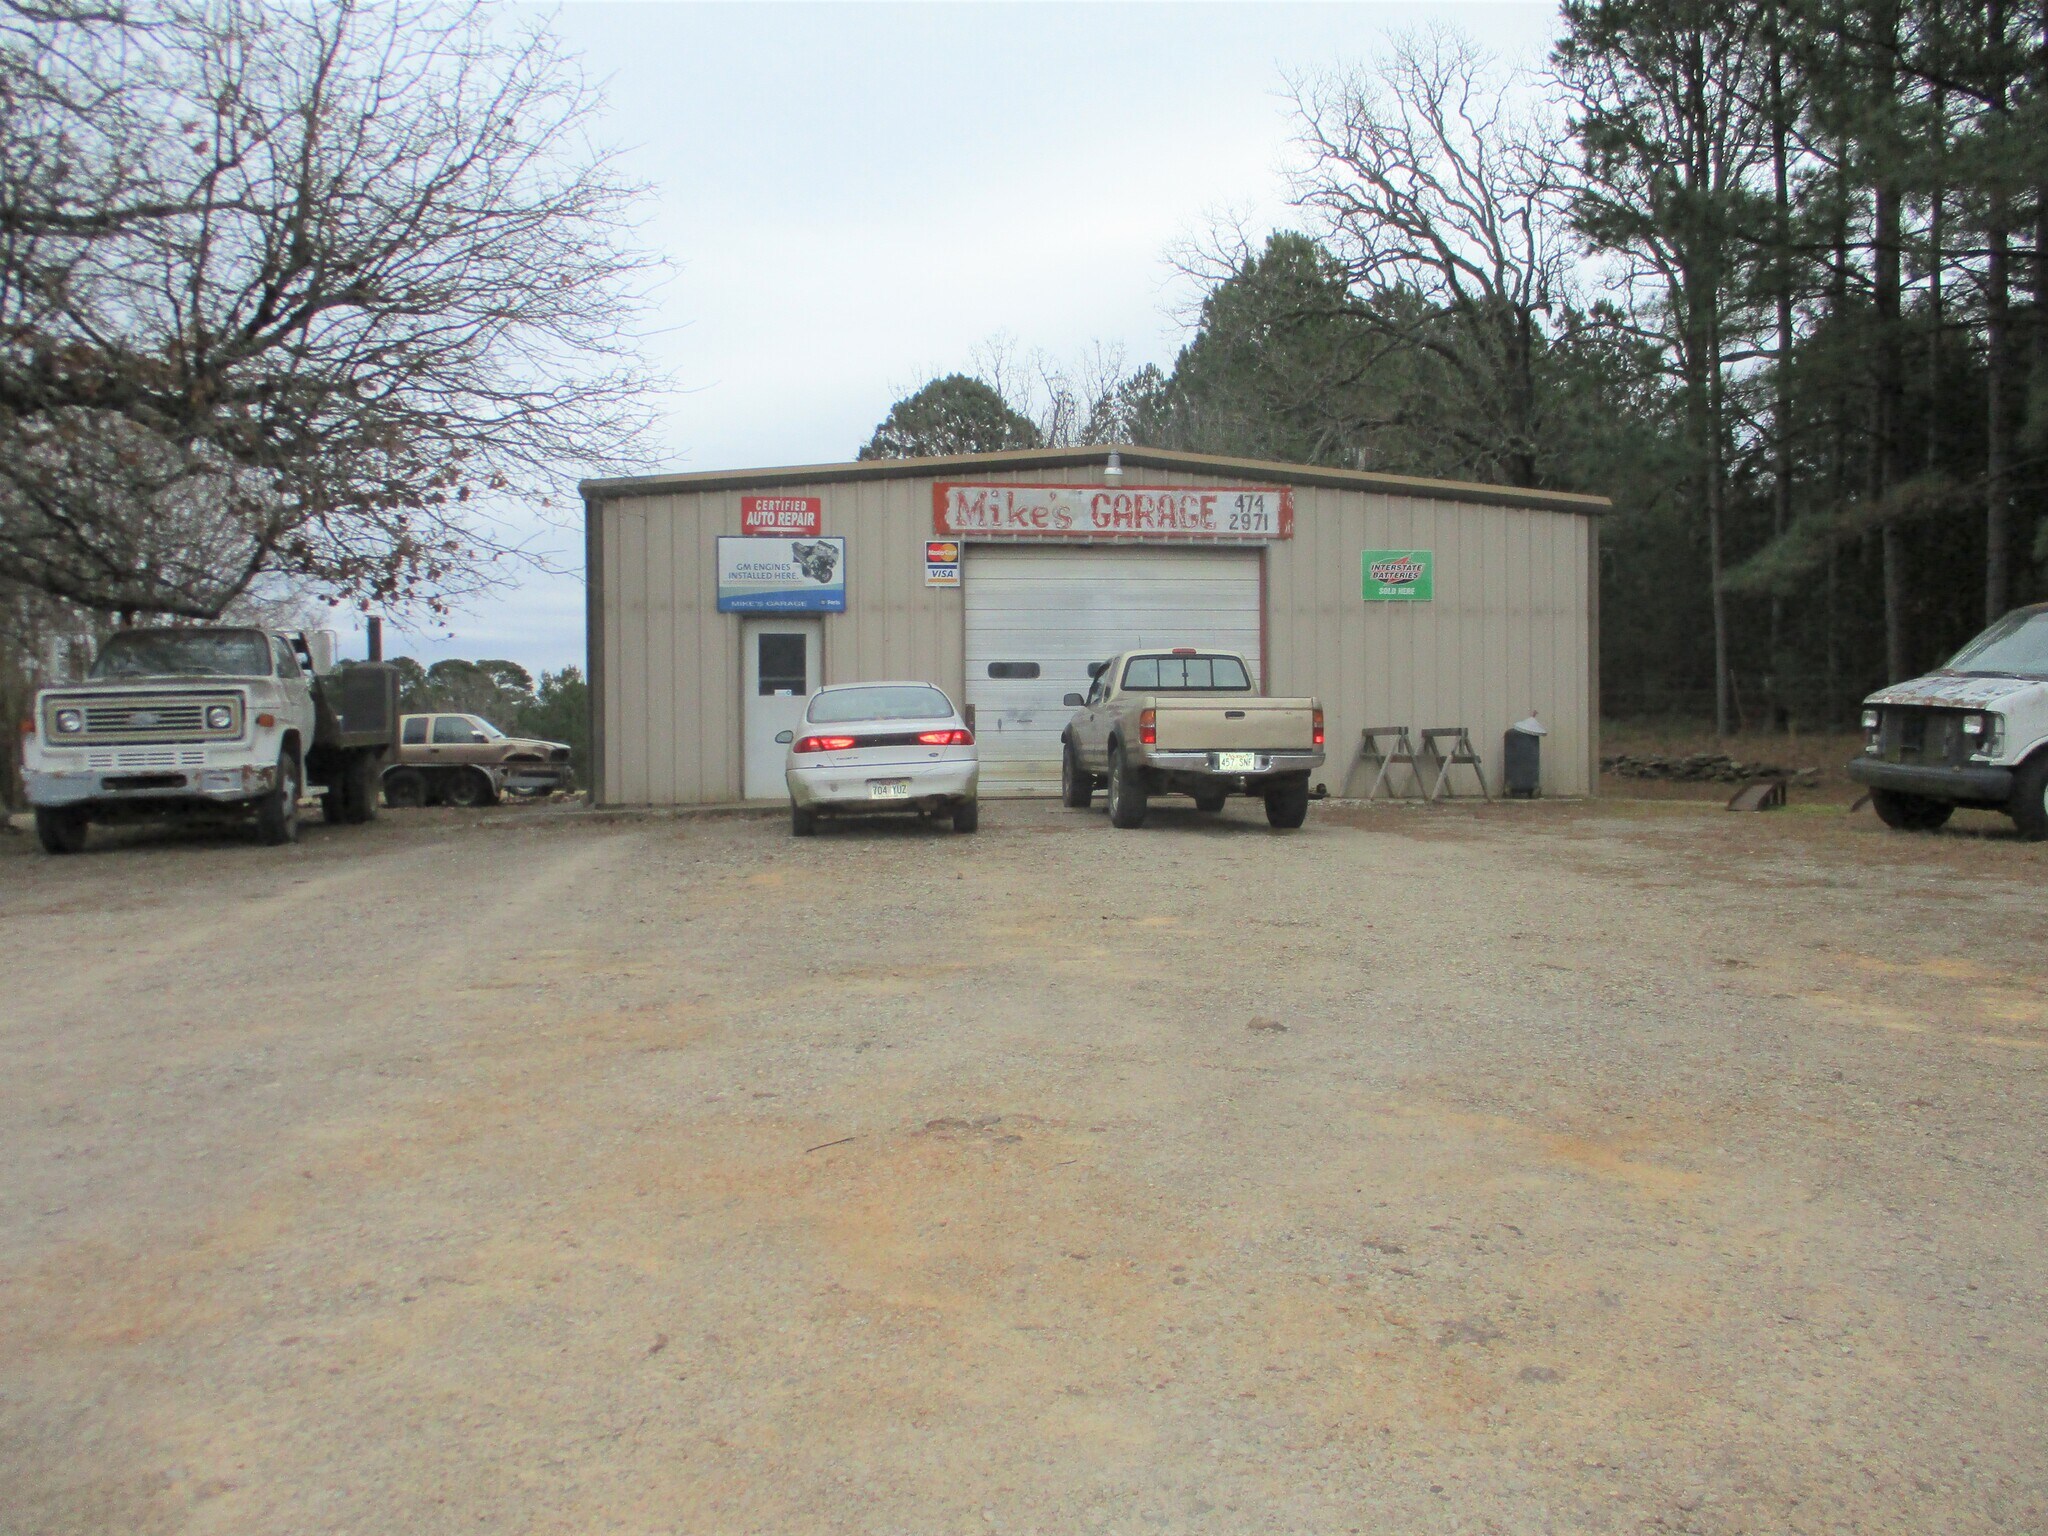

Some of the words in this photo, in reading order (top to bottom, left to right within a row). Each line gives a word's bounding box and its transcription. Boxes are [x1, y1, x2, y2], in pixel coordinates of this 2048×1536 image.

[755, 500, 807, 511] CERTIFIED
[1234, 494, 1264, 513] 474
[955, 490, 1073, 529] Mike's
[1090, 493, 1218, 530] GARAGE
[746, 511, 775, 526] AUTO
[777, 511, 815, 526] REPAIR
[1229, 512, 1268, 531] 2971
[736, 563, 752, 571] GM
[753, 563, 791, 571] ENGINES
[728, 572, 773, 580] INSTALLED
[774, 572, 799, 580] HERE.
[932, 570, 954, 578] VISA
[1378, 587, 1397, 595] SOLD
[1398, 587, 1416, 595] HERE
[872, 785, 887, 795] 704
[892, 784, 907, 794] YUZ
